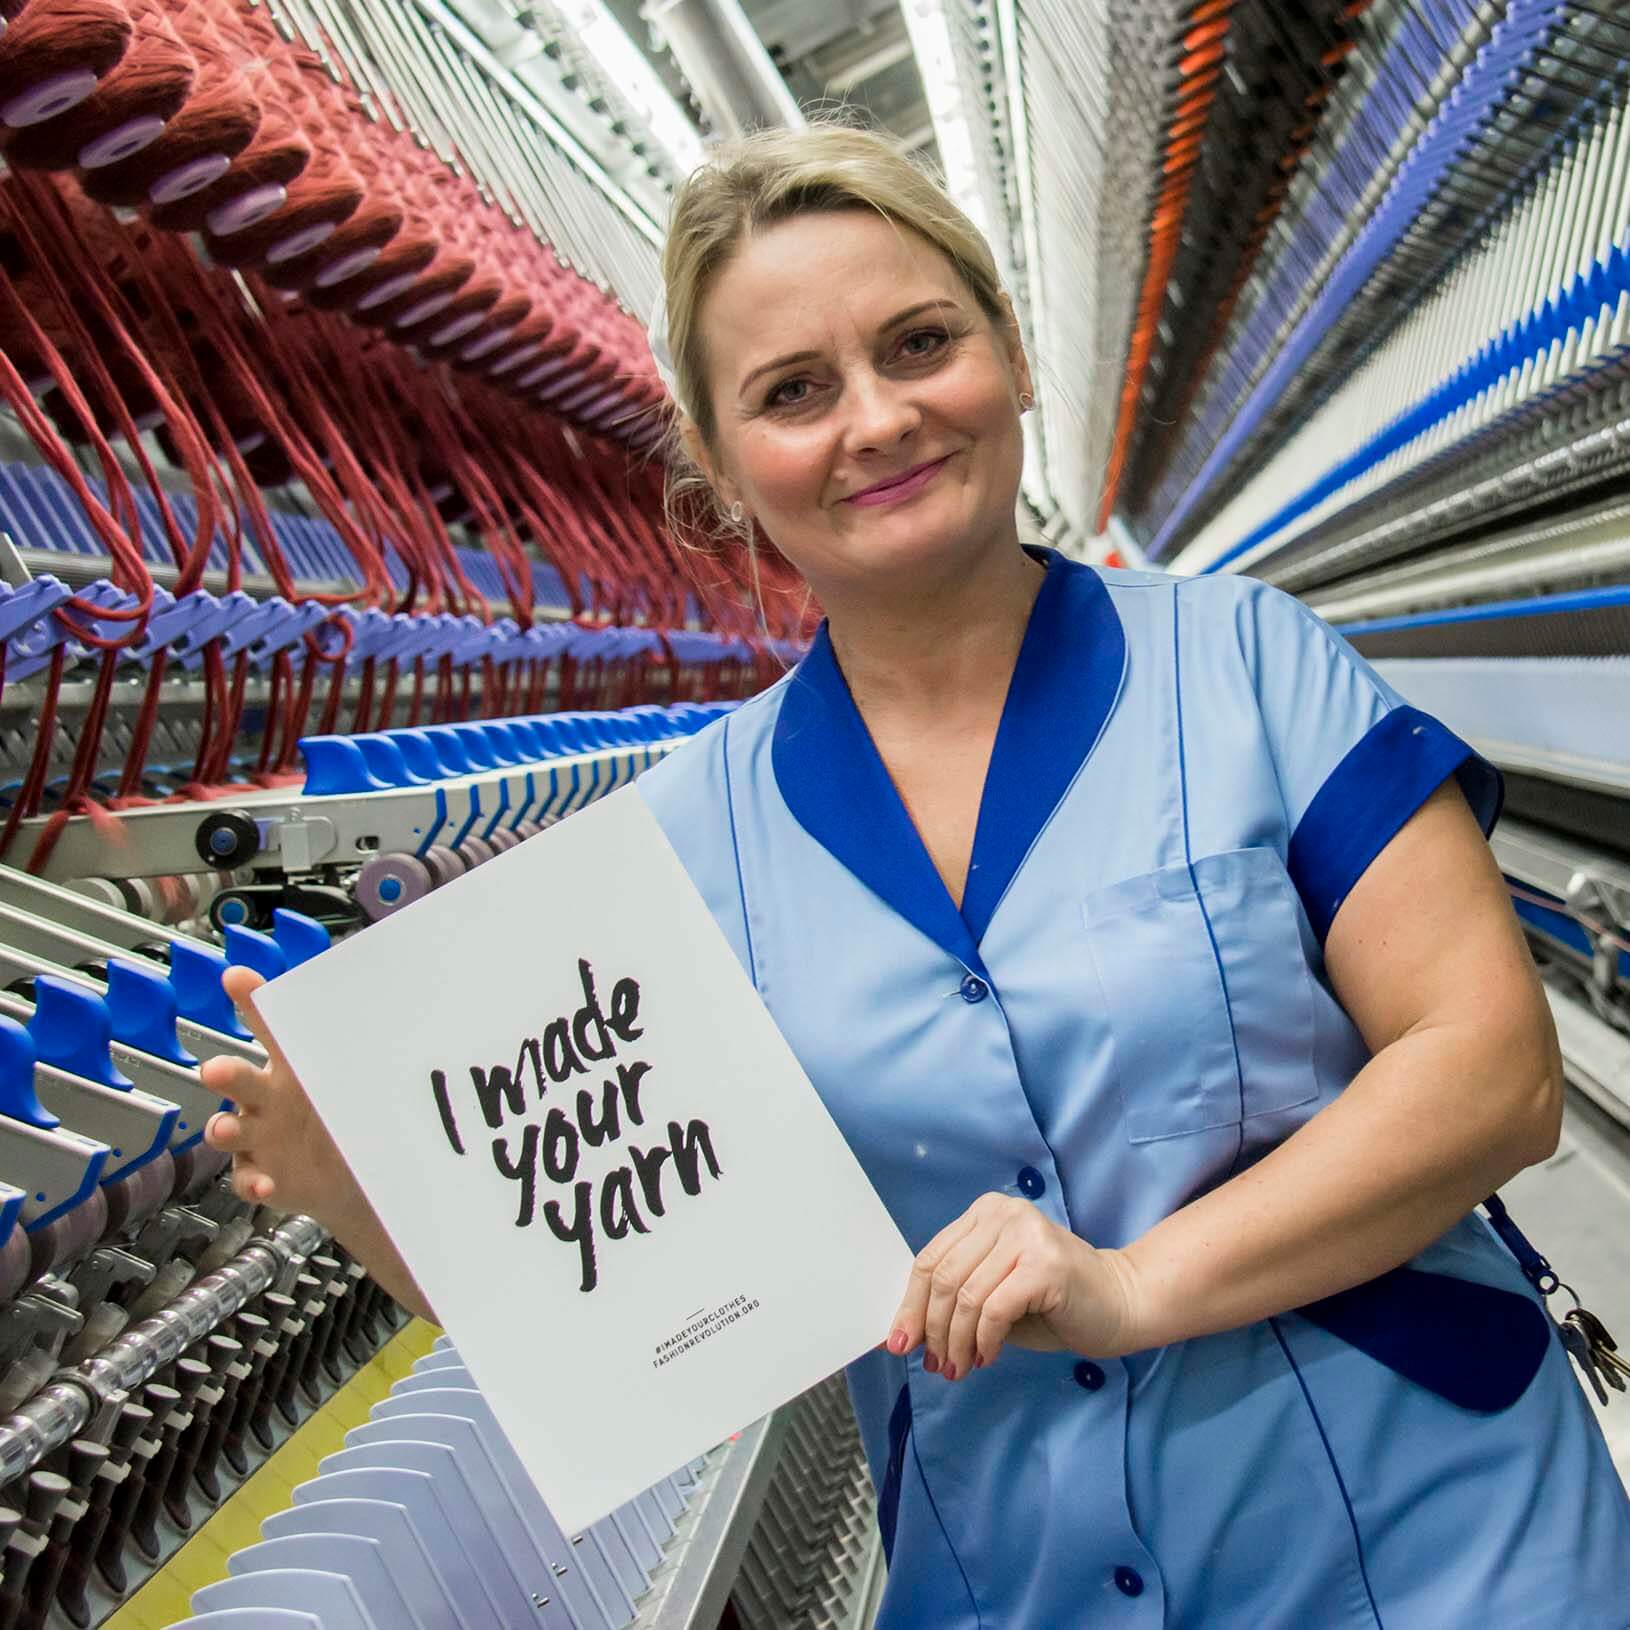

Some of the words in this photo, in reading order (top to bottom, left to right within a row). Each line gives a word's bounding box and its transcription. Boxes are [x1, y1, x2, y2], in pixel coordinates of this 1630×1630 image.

[430, 1068, 465, 1156] I
[469, 958, 645, 1130] made
[491, 1060, 653, 1228] your
[542, 1118, 724, 1293] yarn
[652, 1299, 761, 1369] FASHIONREVOLUTION.ORG
[655, 1294, 747, 1355] #IMADEYOURCLOTHES
